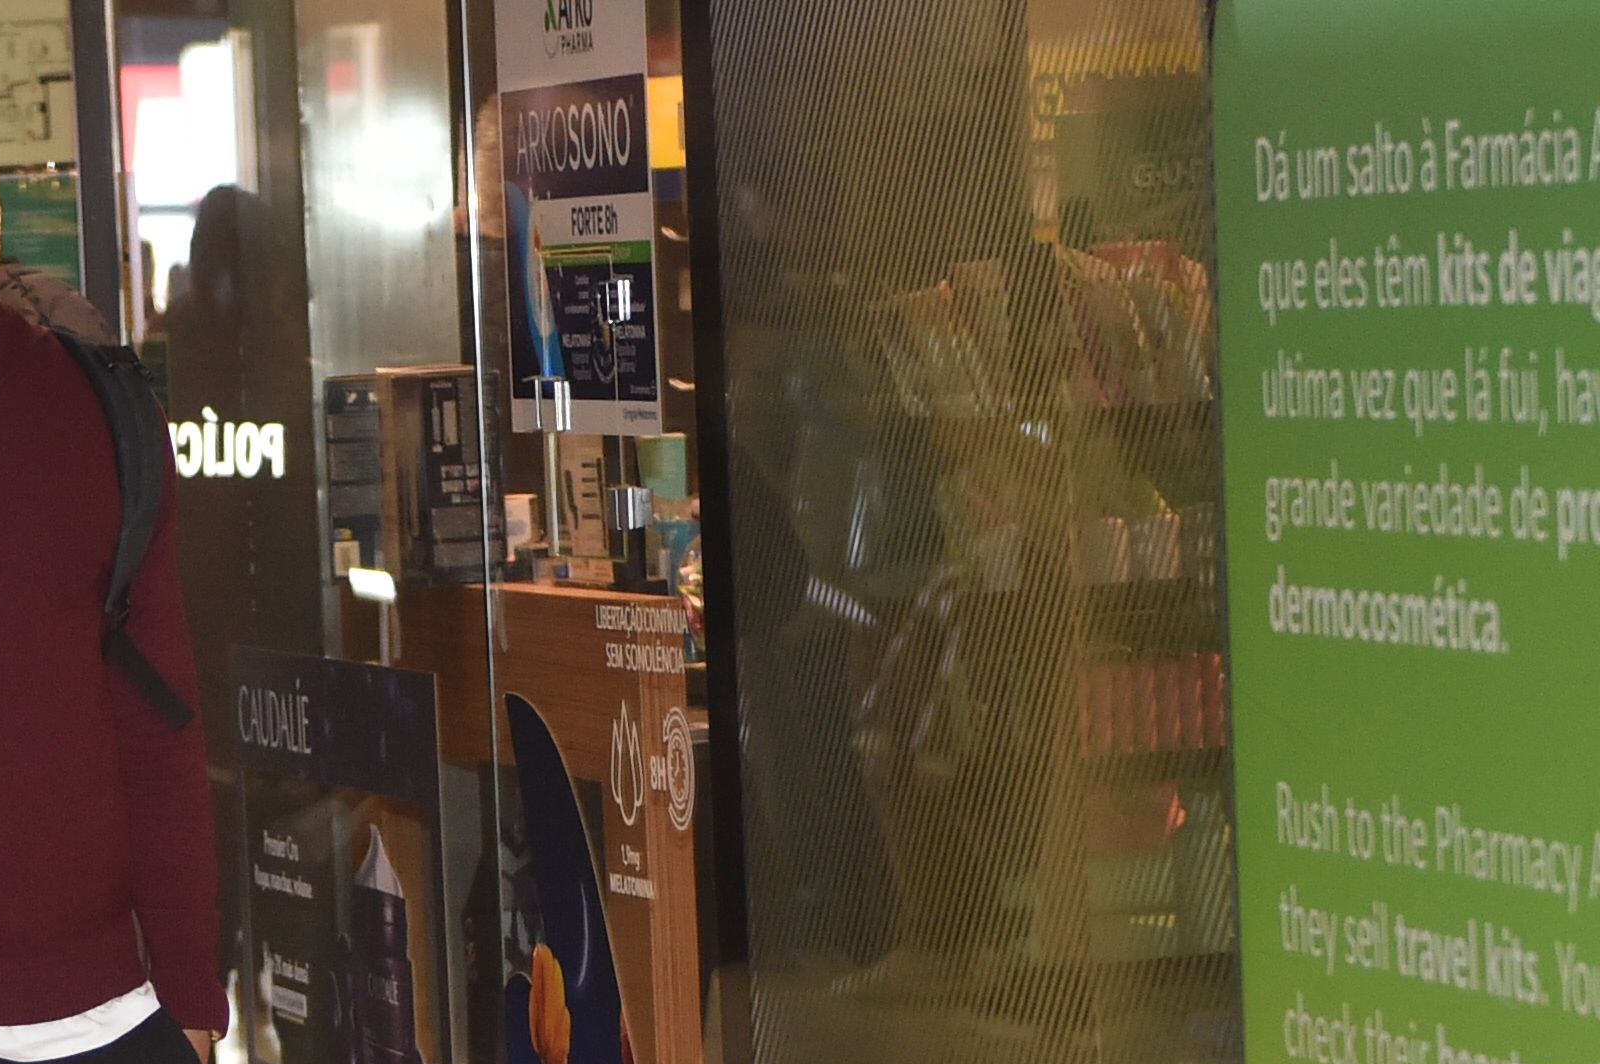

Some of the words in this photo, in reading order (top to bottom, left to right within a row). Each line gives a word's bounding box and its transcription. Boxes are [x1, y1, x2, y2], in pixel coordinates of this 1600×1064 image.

[517, 98, 631, 175] ARKOSONO
[1256, 131, 1289, 202] Dá
[1297, 147, 1339, 199] um
[1347, 123, 1413, 196] salto
[1421, 119, 1437, 191] à
[1445, 110, 1581, 189] Farmácia
[571, 206, 603, 236] FORTE
[605, 203, 618, 235] 8h
[1259, 260, 1308, 325] que
[1314, 239, 1368, 309] eles
[1374, 235, 1430, 307] têm
[1438, 234, 1491, 305] kits
[1498, 230, 1538, 304] de
[1262, 351, 1345, 419] ultima
[1351, 369, 1396, 420] vez
[1404, 369, 1458, 435] que
[1465, 349, 1491, 421] lá
[1498, 346, 1548, 435] fui,
[1266, 461, 1356, 542] grande
[1362, 464, 1503, 538] variedade
[1511, 467, 1549, 541] de
[596, 602, 642, 639] LIBERTAÇÃO
[644, 603, 689, 634] CONTÍNUA
[1269, 566, 1508, 653] dermocosmética.
[606, 643, 624, 668] SEM
[625, 640, 685, 675] SONOLÊNCIA
[650, 754, 667, 791] 8H
[1277, 781, 1339, 851] Rush
[1345, 799, 1375, 860] to
[1380, 796, 1428, 870] the
[1435, 806, 1582, 912] Pharmacy
[1279, 886, 1337, 975] they
[1344, 903, 1389, 969] sell
[1394, 915, 1479, 989] travel
[1485, 923, 1548, 1005] kits.
